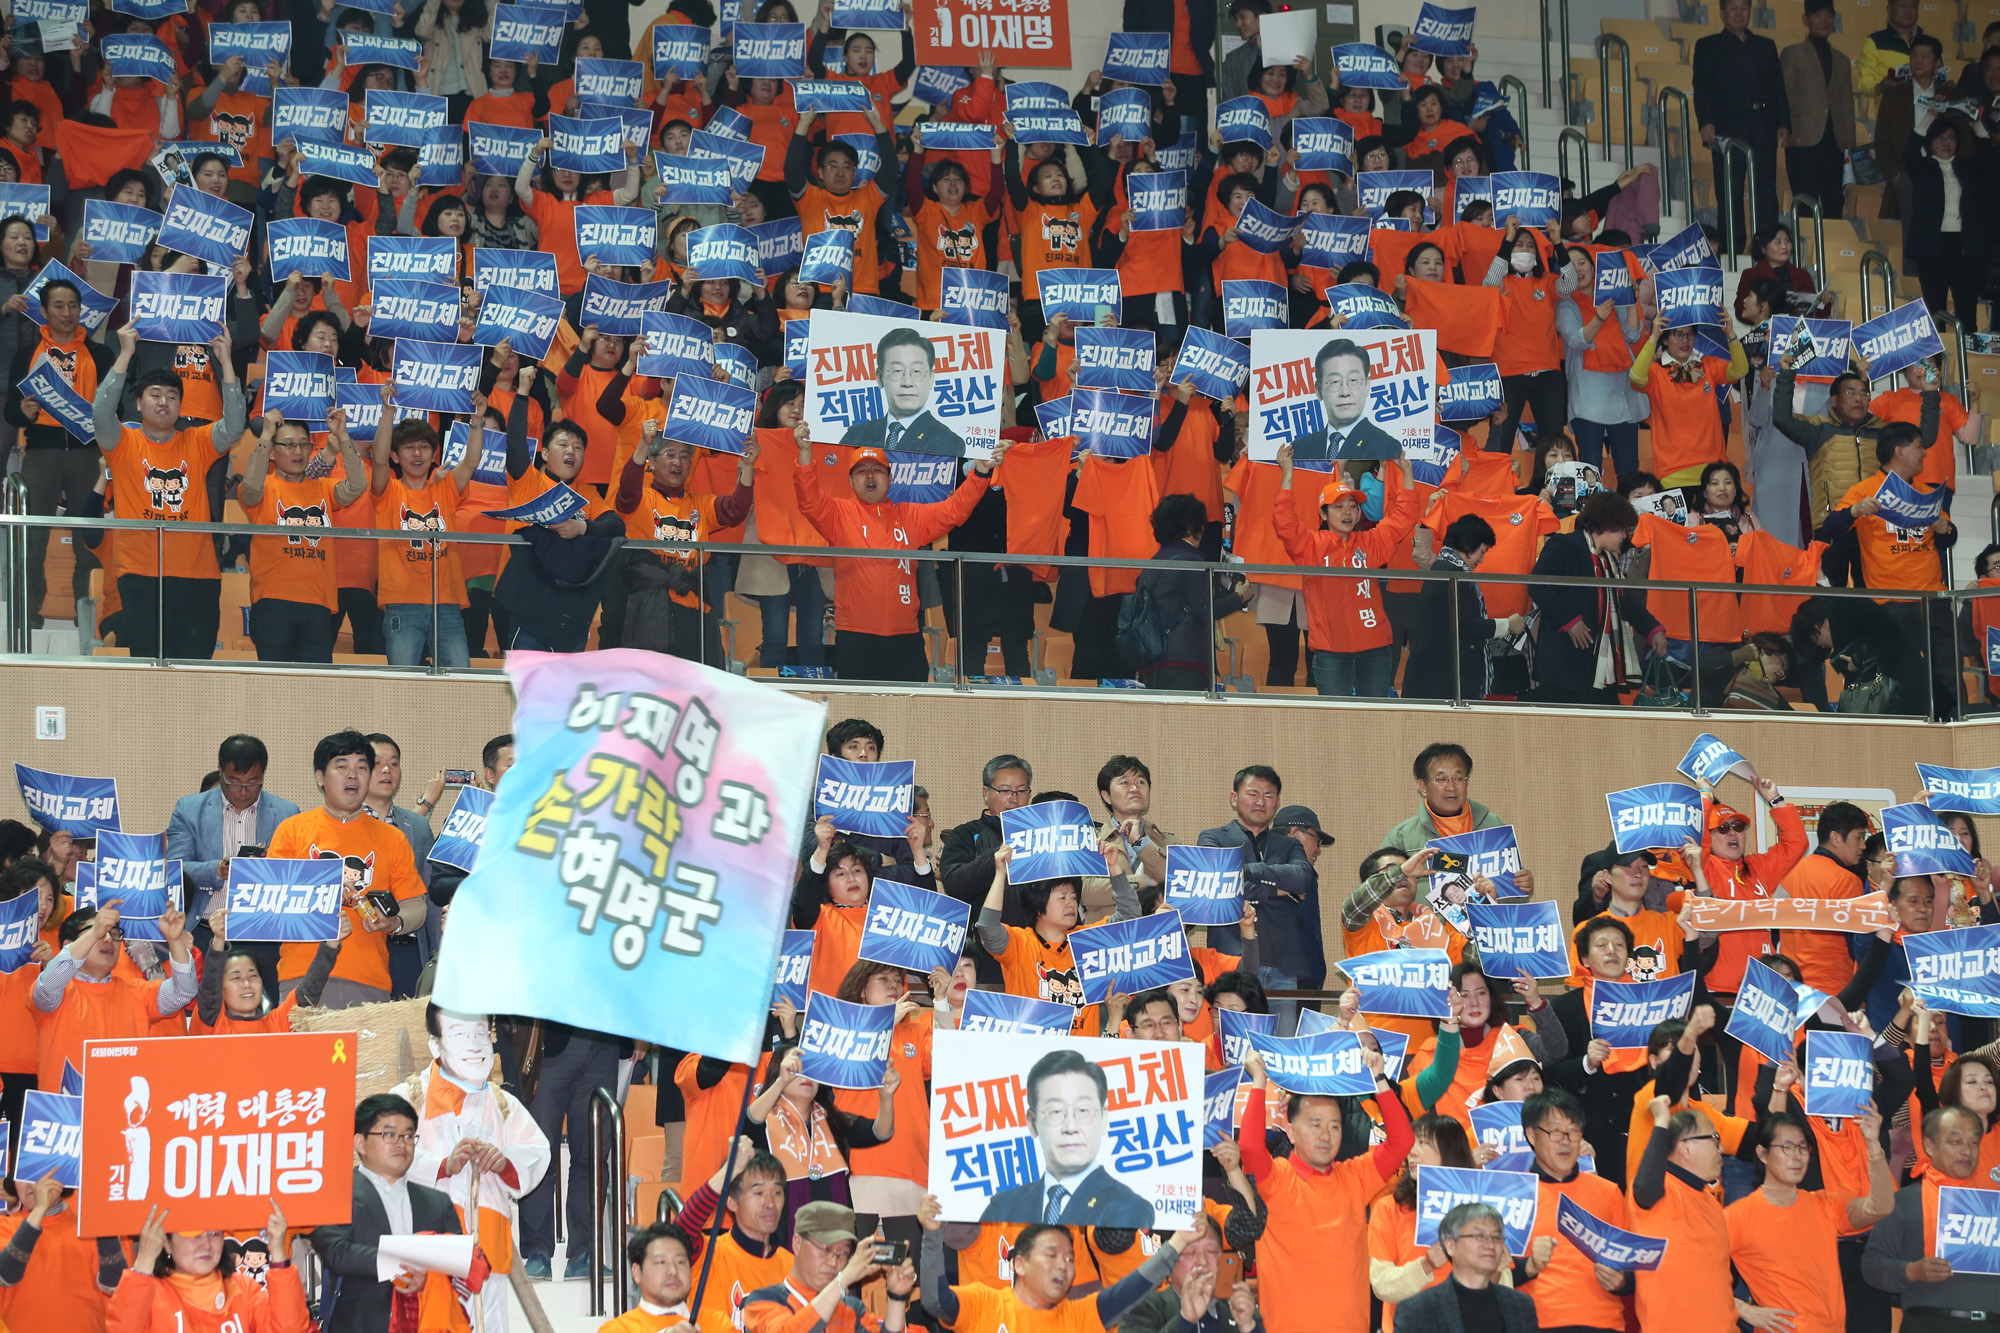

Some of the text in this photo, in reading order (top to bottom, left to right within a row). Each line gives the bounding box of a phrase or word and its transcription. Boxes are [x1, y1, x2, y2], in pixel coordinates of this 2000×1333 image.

[213, 31, 289, 52] 진짜교체
[495, 21, 561, 47] 진짜교체
[960, 14, 1054, 50] 이재명
[1419, 17, 1473, 42] 진짜교체
[105, 45, 175, 70] 진짜교체
[736, 39, 803, 60] 진짜교체
[1107, 48, 1168, 70] 진짜교체
[578, 74, 642, 99] 진짜교체
[275, 103, 346, 131] 진짜교체
[1014, 116, 1081, 132] 진짜교체
[302, 142, 374, 170] 진짜교체
[553, 130, 621, 154] 진짜교체
[662, 165, 731, 188] 진짜교체
[0, 201, 48, 224] 교체
[1494, 188, 1561, 211] 진짜교체
[167, 204, 249, 251] 진짜교체
[580, 223, 655, 248] 진짜교체
[273, 233, 346, 261] 진짜교체
[690, 240, 759, 264] 진짜교체
[760, 231, 801, 257] 짜교체
[370, 253, 452, 274] 진짜교체
[135, 293, 224, 323] 진짜교체
[945, 285, 1008, 314] 진짜교체
[1045, 283, 1117, 305] 진짜교체
[1337, 296, 1400, 319] 진짜교체
[1660, 286, 1722, 309] 진짜교체
[373, 296, 458, 327] 진짜교체
[480, 302, 557, 340] 진짜교체
[645, 331, 715, 364] 진짜교체
[1772, 333, 1848, 359] 진교체
[1860, 314, 1931, 362] 진짜교체
[811, 342, 878, 386] 진짜
[931, 331, 994, 373] 교체
[1080, 345, 1153, 372] 진짜교체
[1179, 344, 1249, 388] 진짜교체
[1252, 333, 1425, 405] 진짜 교체
[396, 360, 480, 391] 진짜교체
[672, 394, 753, 435] 진짜교체
[816, 374, 997, 429] 적폐 청산
[1260, 376, 1430, 443] 적폐 청산
[1072, 408, 1151, 440] 진짜교체
[965, 437, 996, 449] 이재명
[1402, 437, 1431, 449] 이재명
[567, 683, 771, 844] 이재명 과
[23, 785, 114, 821] 진짜교체
[818, 778, 912, 814] 진짜교체
[516, 753, 682, 879] 손가락
[1617, 802, 1702, 832] 진짜교체
[1009, 823, 1099, 860] 진짜교체
[232, 882, 341, 914] 진짜교체
[560, 821, 722, 969] 혁명군
[0, 912, 39, 950] 교체
[872, 904, 966, 955] 진짜교체
[1476, 924, 1558, 954] 진짜교체
[1082, 931, 1182, 981] 진짜교체
[1352, 963, 1450, 991] 진짜교체
[91, 1046, 138, 1057] 더불어민주당
[801, 1018, 892, 1063] 진짜교체
[1258, 1047, 1362, 1077] 진짜교체
[935, 1074, 1027, 1140] 진짜
[1095, 1047, 1189, 1112] 교체
[166, 1088, 327, 1131] 개혁 대통령
[163, 1129, 325, 1199] 이재명
[946, 1109, 1195, 1197] 적폐 청산
[108, 1164, 125, 1201] 기호
[1154, 1184, 1175, 1197] 기호
[1155, 1199, 1196, 1215] 이재명
[1558, 1211, 1662, 1264] 진짜교체
